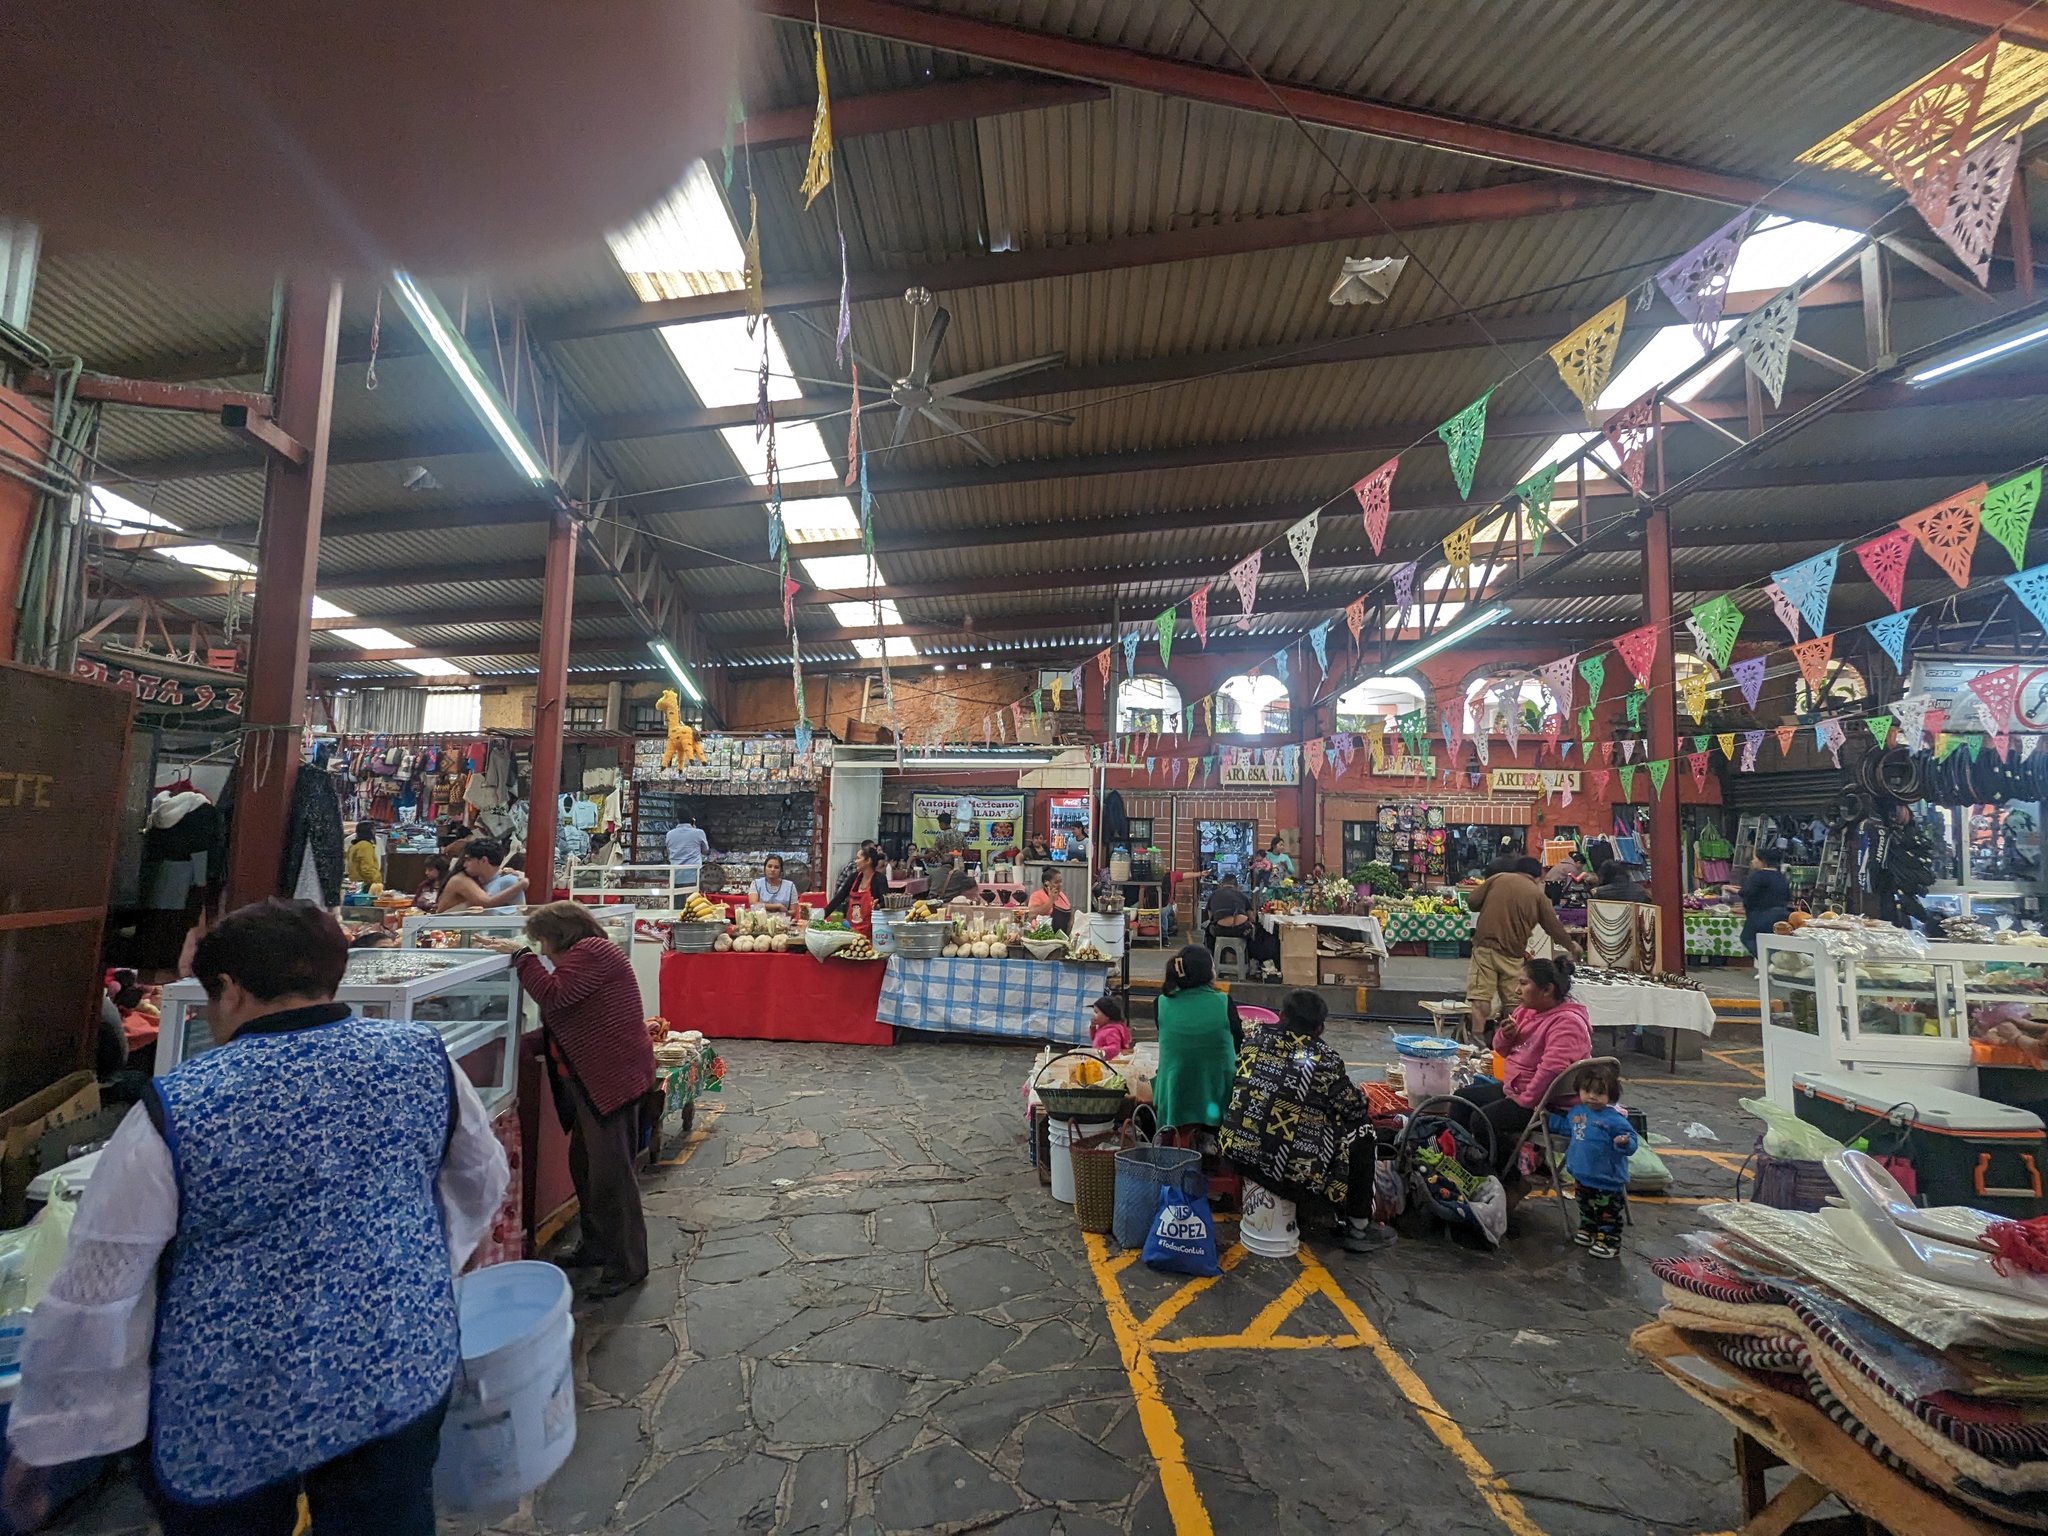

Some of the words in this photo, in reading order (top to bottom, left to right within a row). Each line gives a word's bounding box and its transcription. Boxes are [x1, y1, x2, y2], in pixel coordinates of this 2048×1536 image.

[1226, 768, 1295, 781] ARTESAIAS
[1496, 773, 1574, 788] ARTESAIAS
[1161, 1218, 1204, 1238] LÓPEZ
[1158, 1239, 1205, 1255] #TodosConLuis
